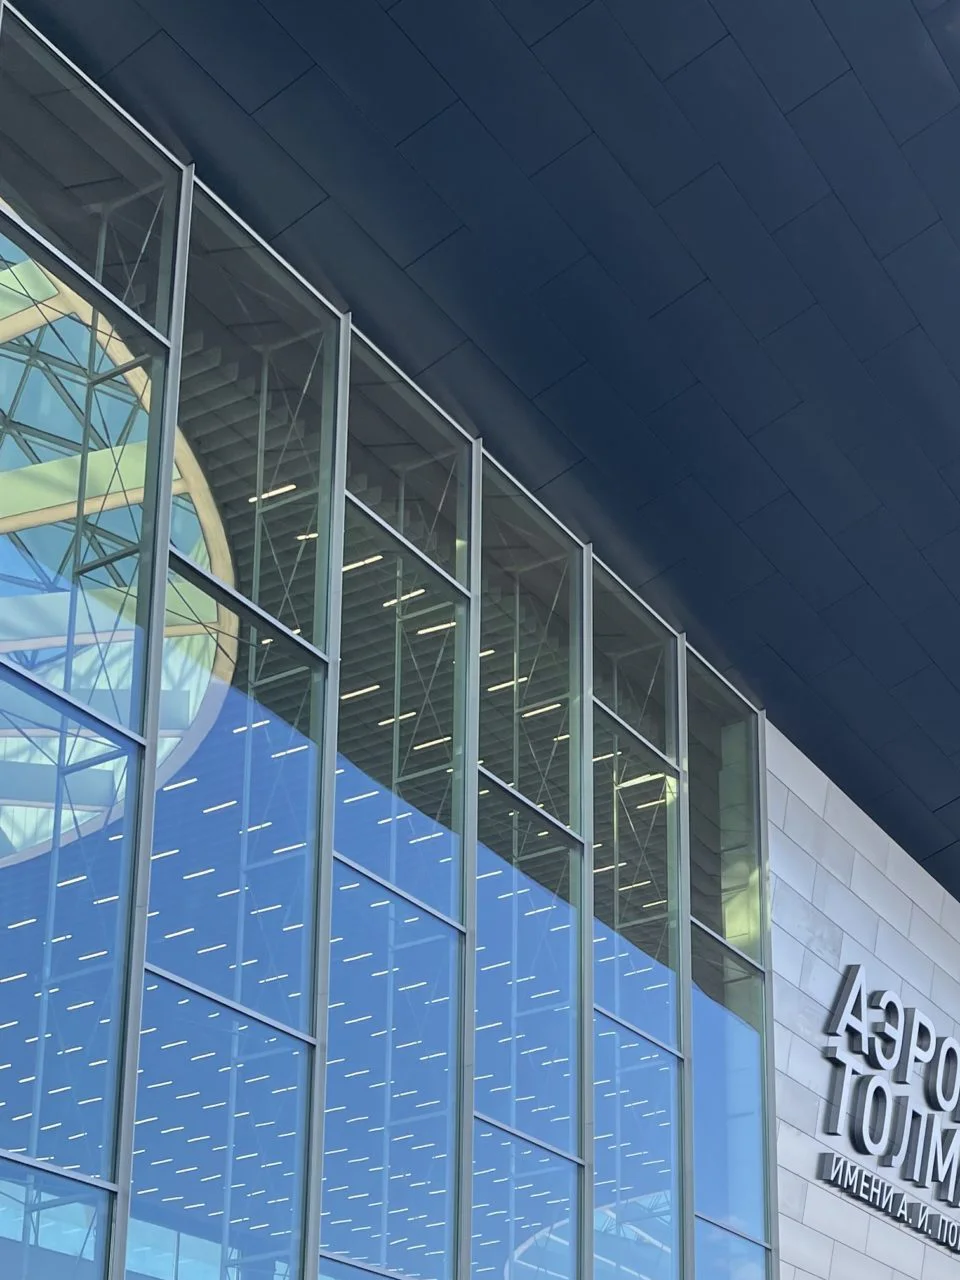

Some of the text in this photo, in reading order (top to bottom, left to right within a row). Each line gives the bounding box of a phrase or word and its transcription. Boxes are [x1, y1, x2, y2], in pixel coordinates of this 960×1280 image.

[822, 1153, 894, 1213] ИМЕНИ
[895, 1192, 912, 1224] А.
[914, 1203, 932, 1235] И.
